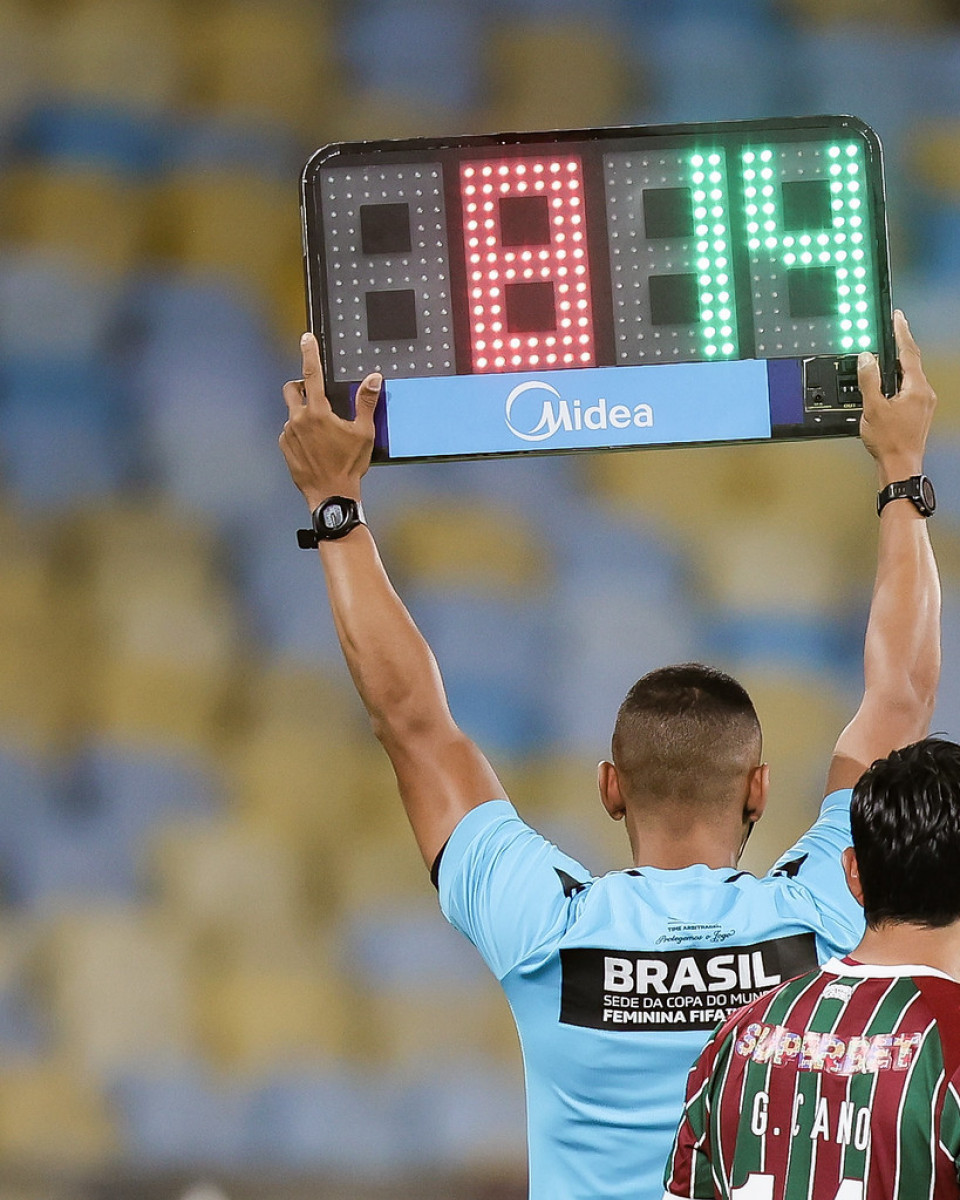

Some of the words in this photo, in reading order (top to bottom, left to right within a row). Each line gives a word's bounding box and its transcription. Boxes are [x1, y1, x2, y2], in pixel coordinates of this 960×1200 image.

[463, 159, 592, 369] 8
[690, 143, 872, 357] 14
[505, 380, 655, 443] Midea
[603, 952, 782, 994] BRASIL
[603, 994, 640, 1008] SEDE
[643, 997, 663, 1008] DA
[667, 995, 703, 1009] COPA
[708, 994, 728, 1007] DO
[603, 1009, 687, 1024] FEMININA
[736, 1022, 922, 1075] SUPERBET
